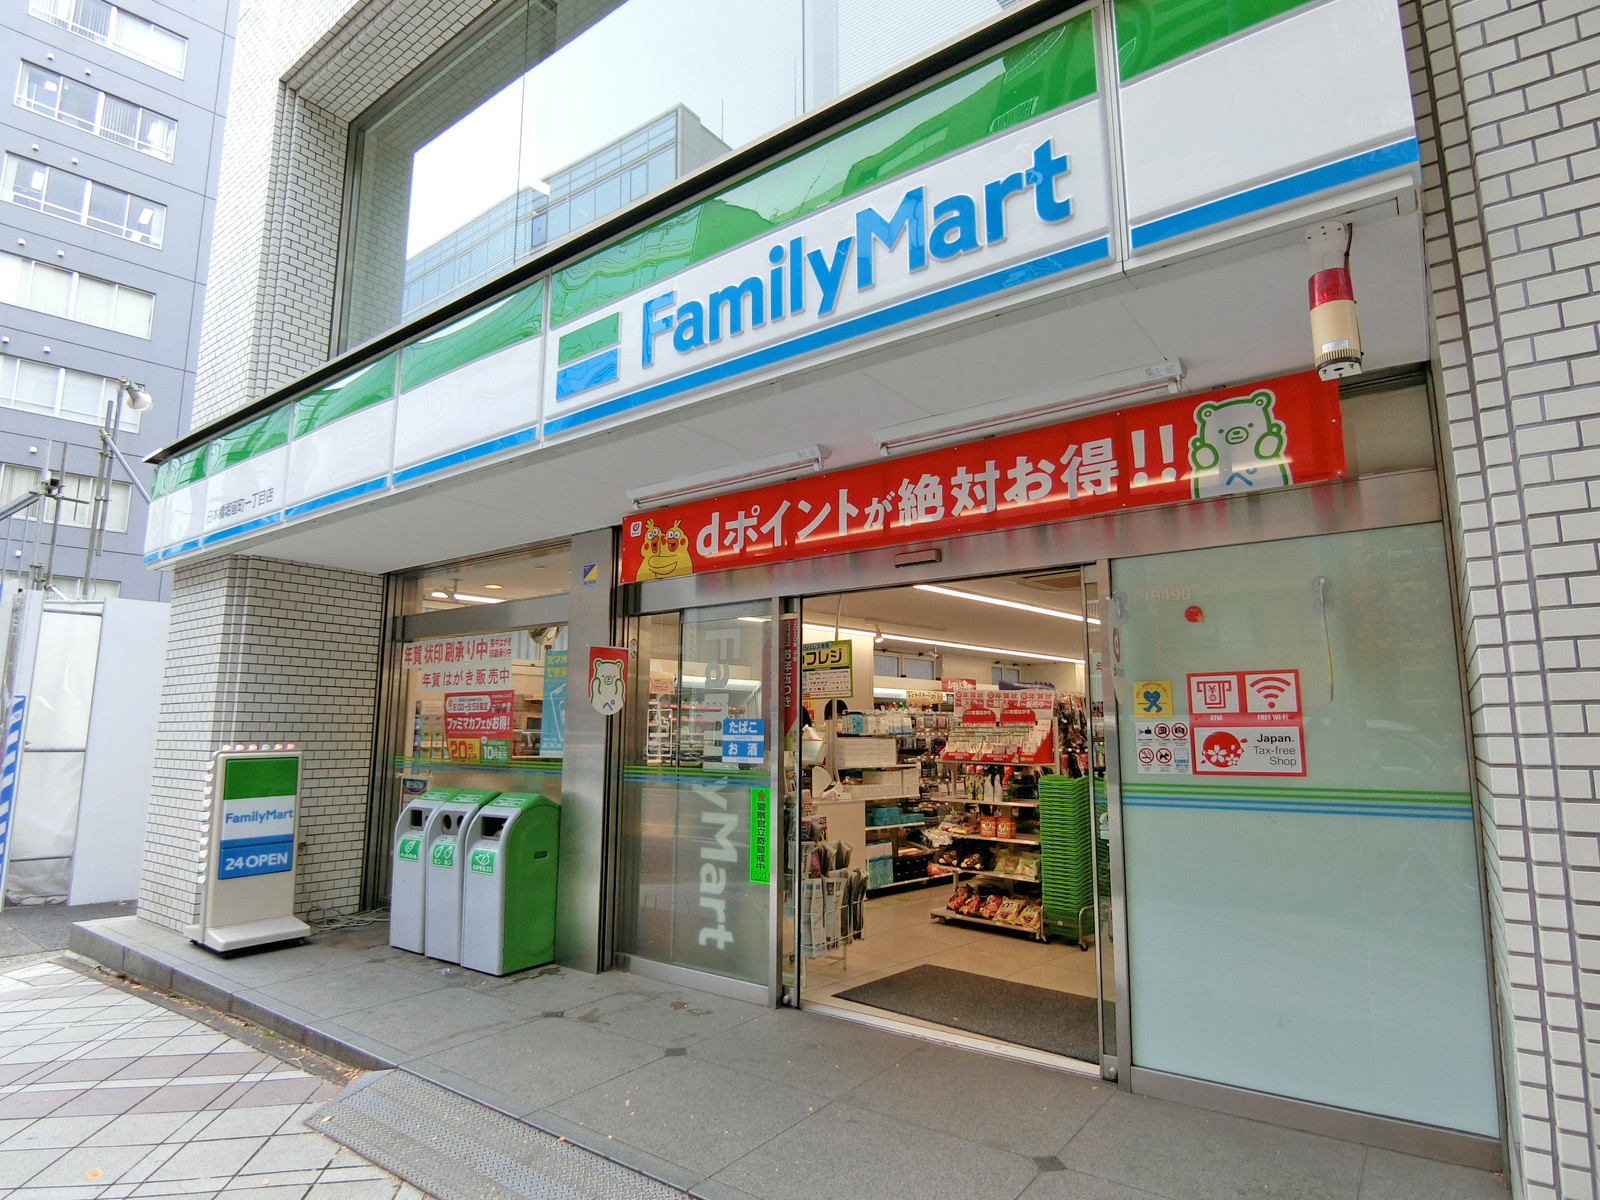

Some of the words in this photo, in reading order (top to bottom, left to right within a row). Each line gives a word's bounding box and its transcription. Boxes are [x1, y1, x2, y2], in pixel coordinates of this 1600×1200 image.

[642, 137, 1071, 368] FamilyMart
[802, 648, 842, 665] フレジ
[422, 667, 510, 688] 年賀はがき販売中
[728, 720, 758, 734] たばこ
[1252, 745, 1296, 755] Tax-free
[1269, 756, 1297, 768] Shop
[225, 809, 294, 824] FamilyMart
[225, 856, 245, 871] 24
[245, 852, 289, 868] OPEN
